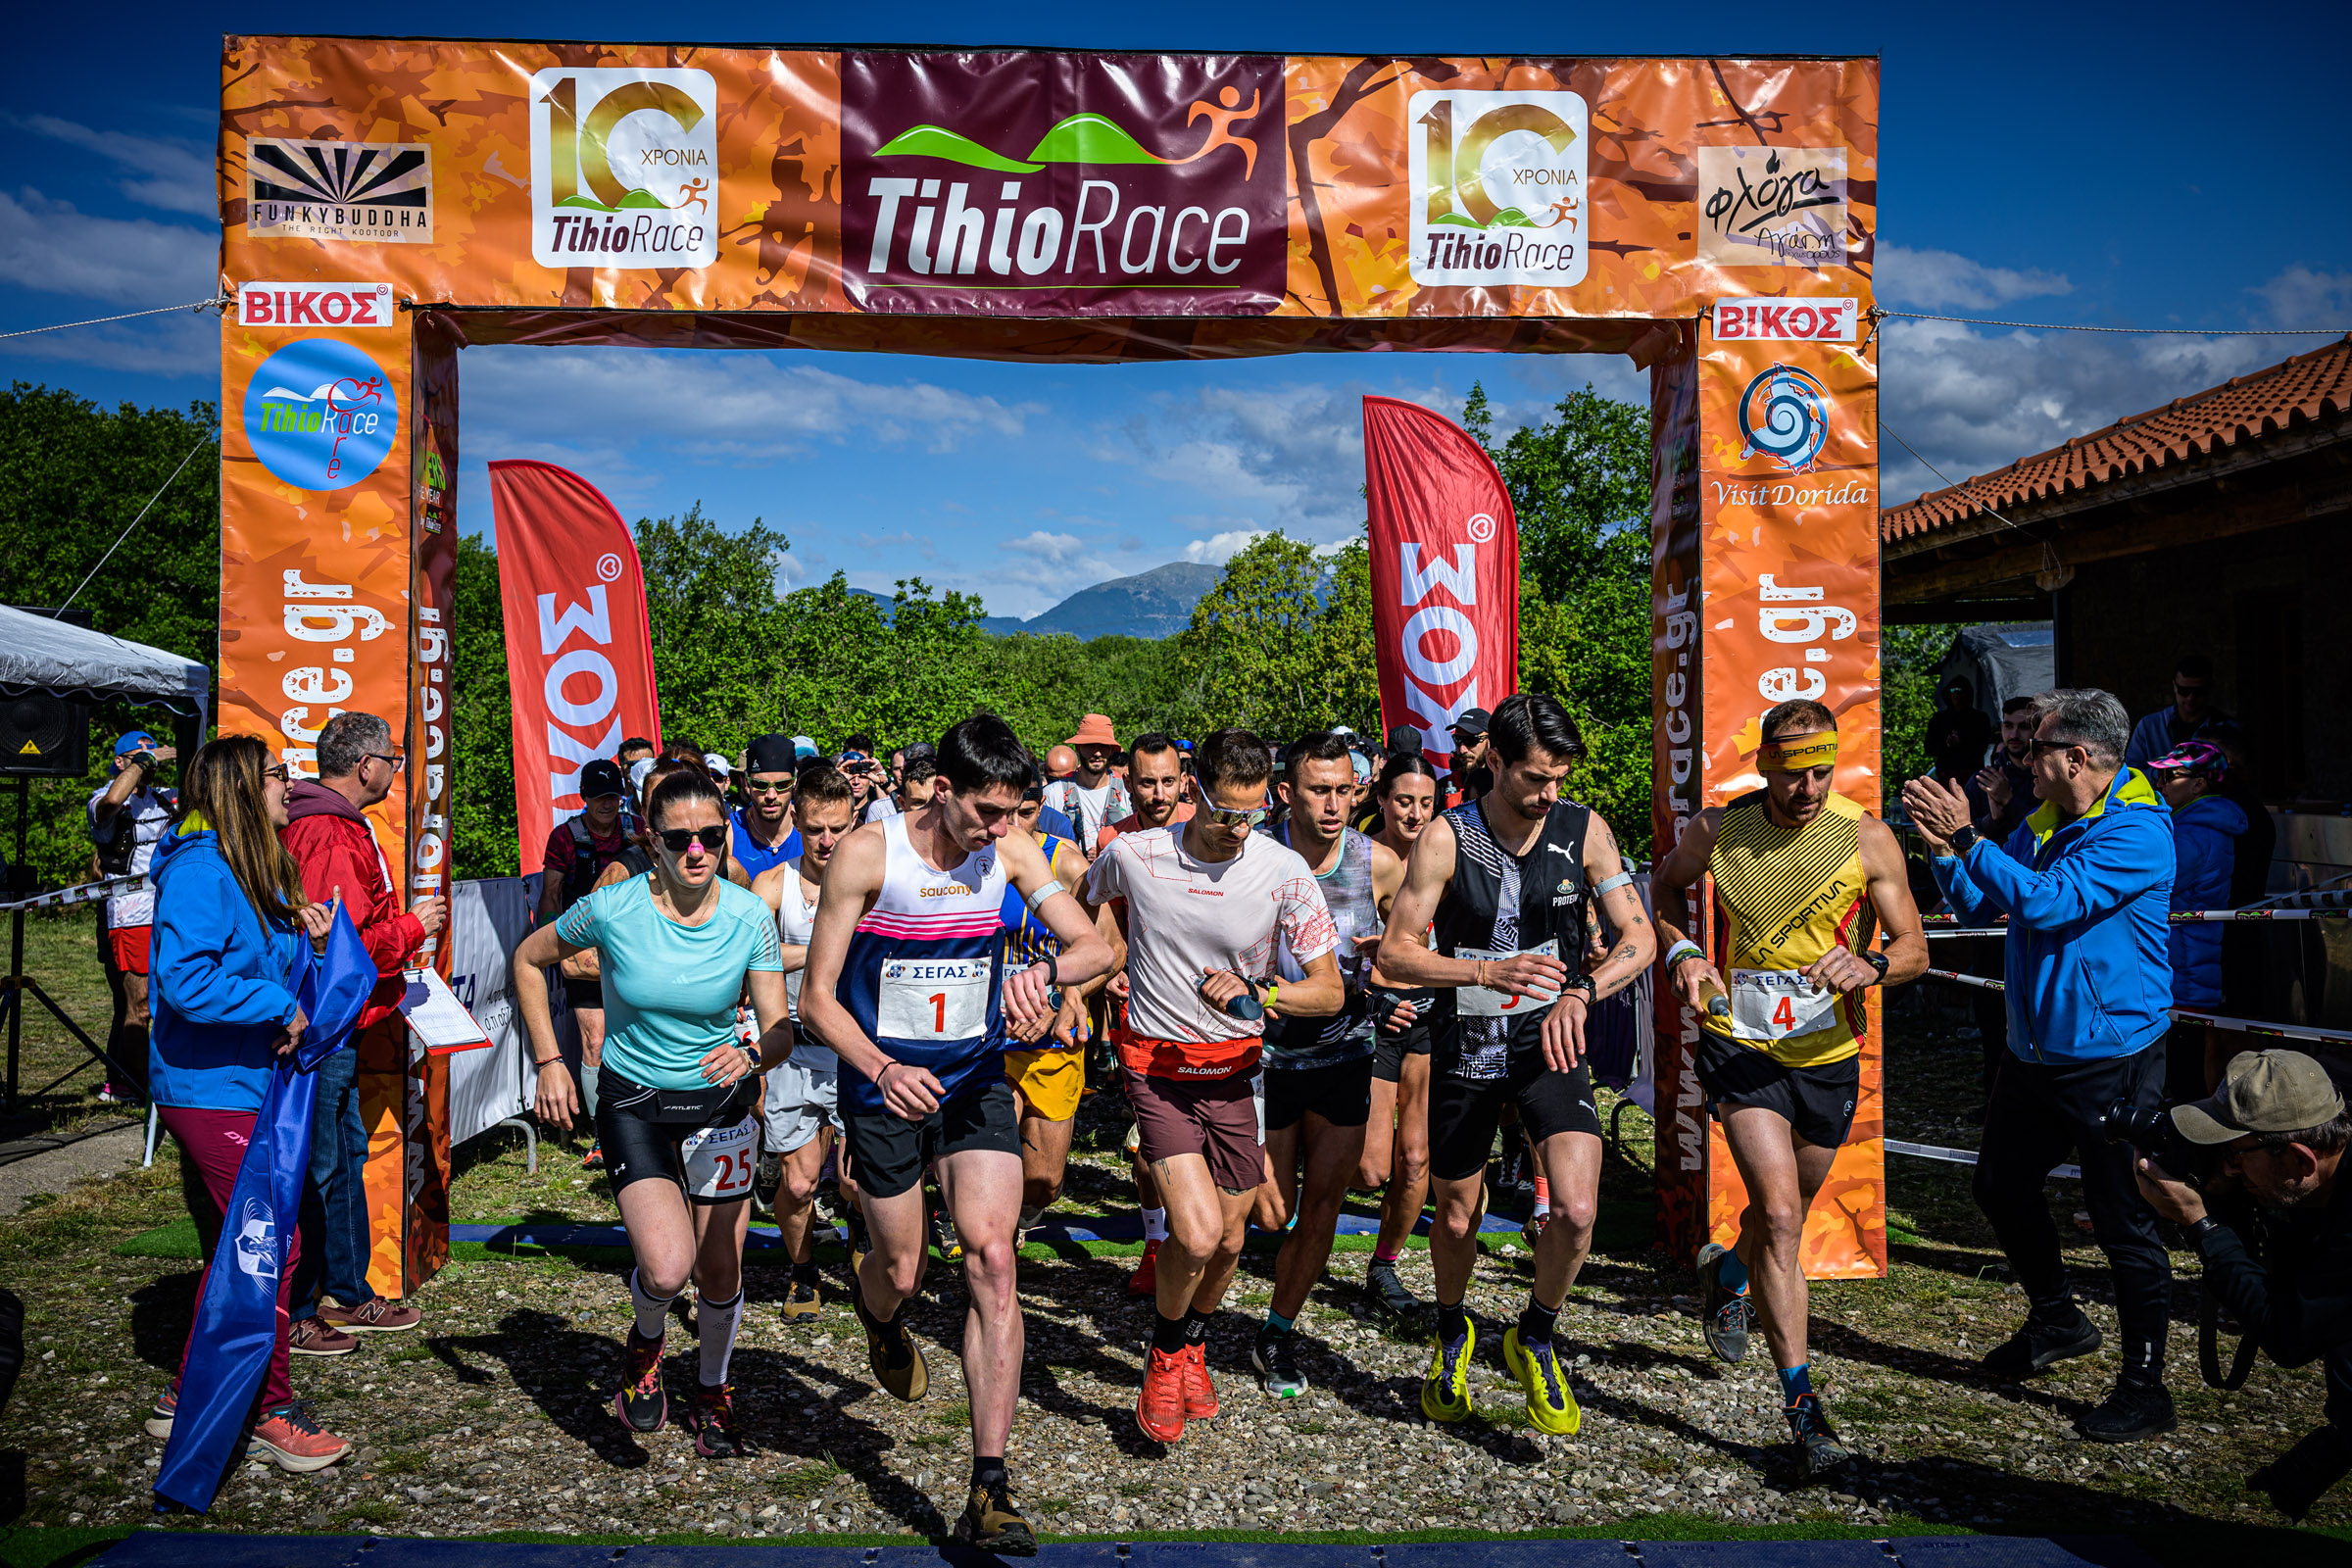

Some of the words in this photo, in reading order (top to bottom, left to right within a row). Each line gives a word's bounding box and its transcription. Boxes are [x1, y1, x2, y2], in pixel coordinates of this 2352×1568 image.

[310, 226, 343, 235] RIGHT
[551, 215, 705, 253] TihioRace
[867, 176, 1250, 275] TihioRace
[1427, 232, 1575, 271] TihioRace
[245, 291, 378, 324] ΒΙΚΟΣ
[1718, 306, 1843, 339] ΒΙΚΟΣ
[260, 402, 379, 435] TihioRace
[1710, 480, 1770, 506] Visit
[1771, 479, 1869, 506] Dorida
[919, 884, 972, 898] saucony
[1188, 888, 1224, 897] SALOMON
[1749, 947, 1774, 966] LA
[1770, 879, 1847, 950] SPORTIVA
[912, 965, 968, 979] ΣΕΓΑΣ
[1755, 975, 1806, 986] ΣΕΓΑΣ
[928, 992, 947, 1034] 1
[1772, 996, 1796, 1031] 4
[1177, 1065, 1232, 1075] SALOMON
[709, 1122, 752, 1145] ΣΕΓΑΣ
[713, 1148, 752, 1192] 25
